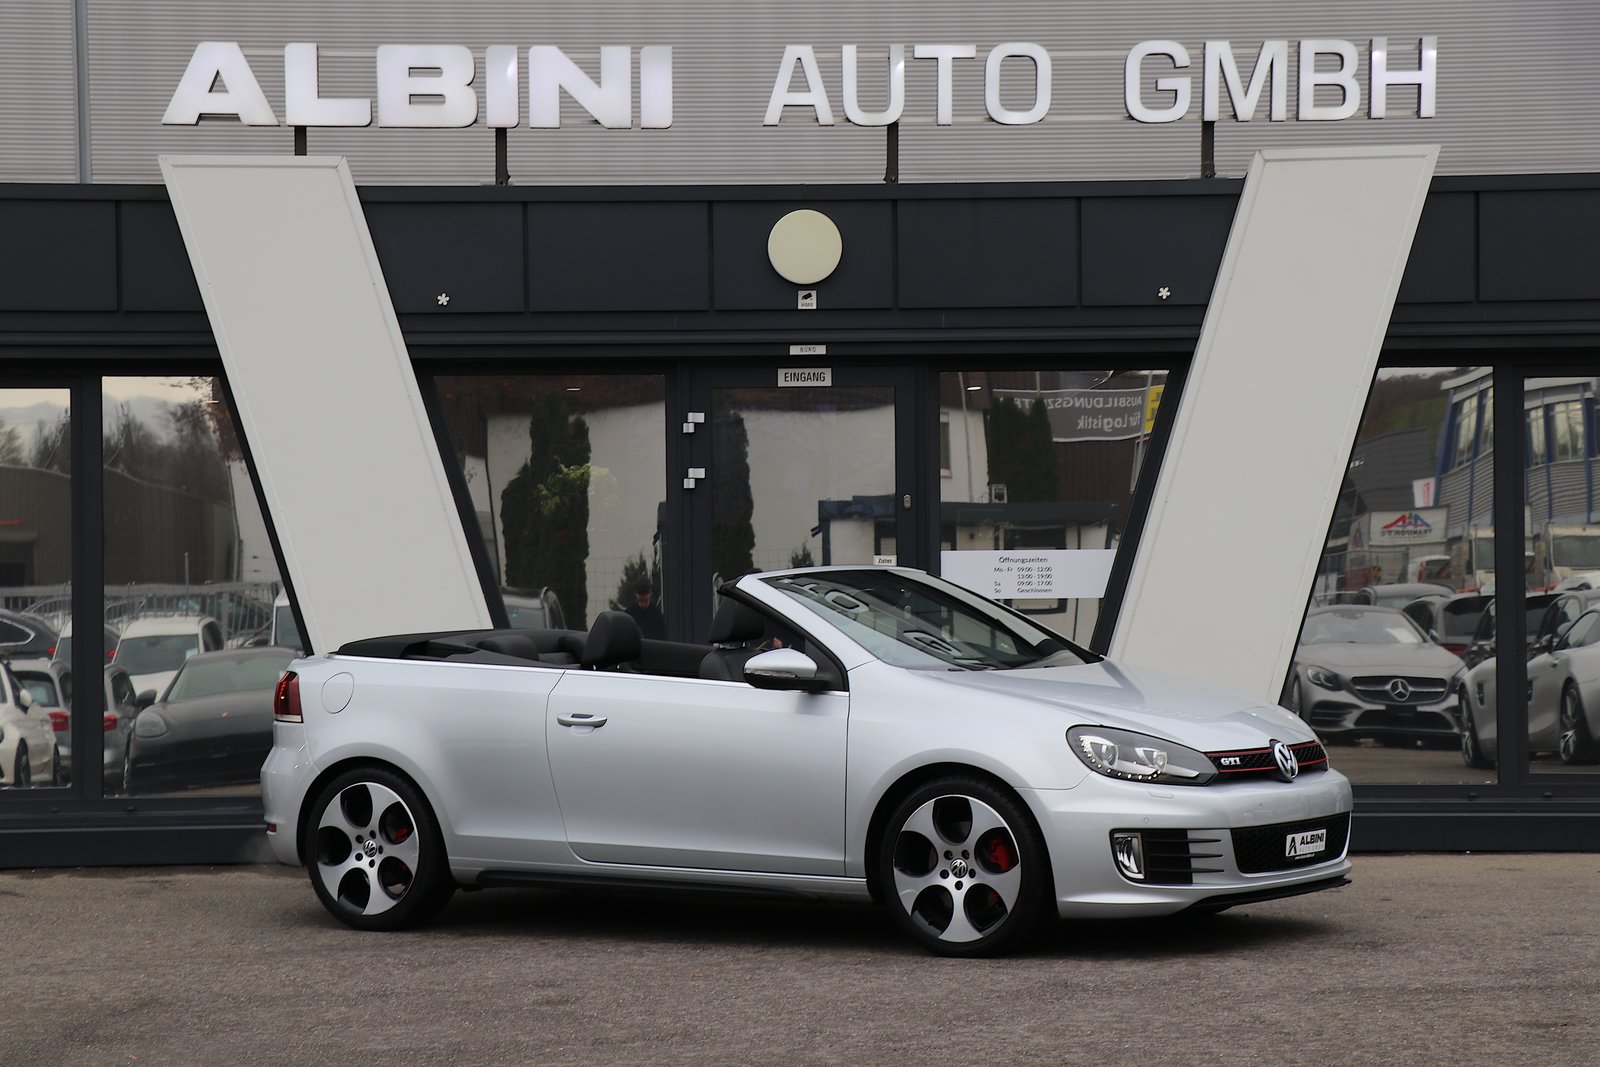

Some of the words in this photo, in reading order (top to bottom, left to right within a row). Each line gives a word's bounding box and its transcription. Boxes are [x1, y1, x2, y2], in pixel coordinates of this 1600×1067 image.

[160, 41, 674, 129] ALBINI
[763, 40, 1053, 127] AUTO
[1124, 35, 1438, 124] GMBH
[784, 371, 826, 382] EINGANG
[1220, 757, 1241, 765] GTI
[1299, 832, 1324, 846] ALBINI
